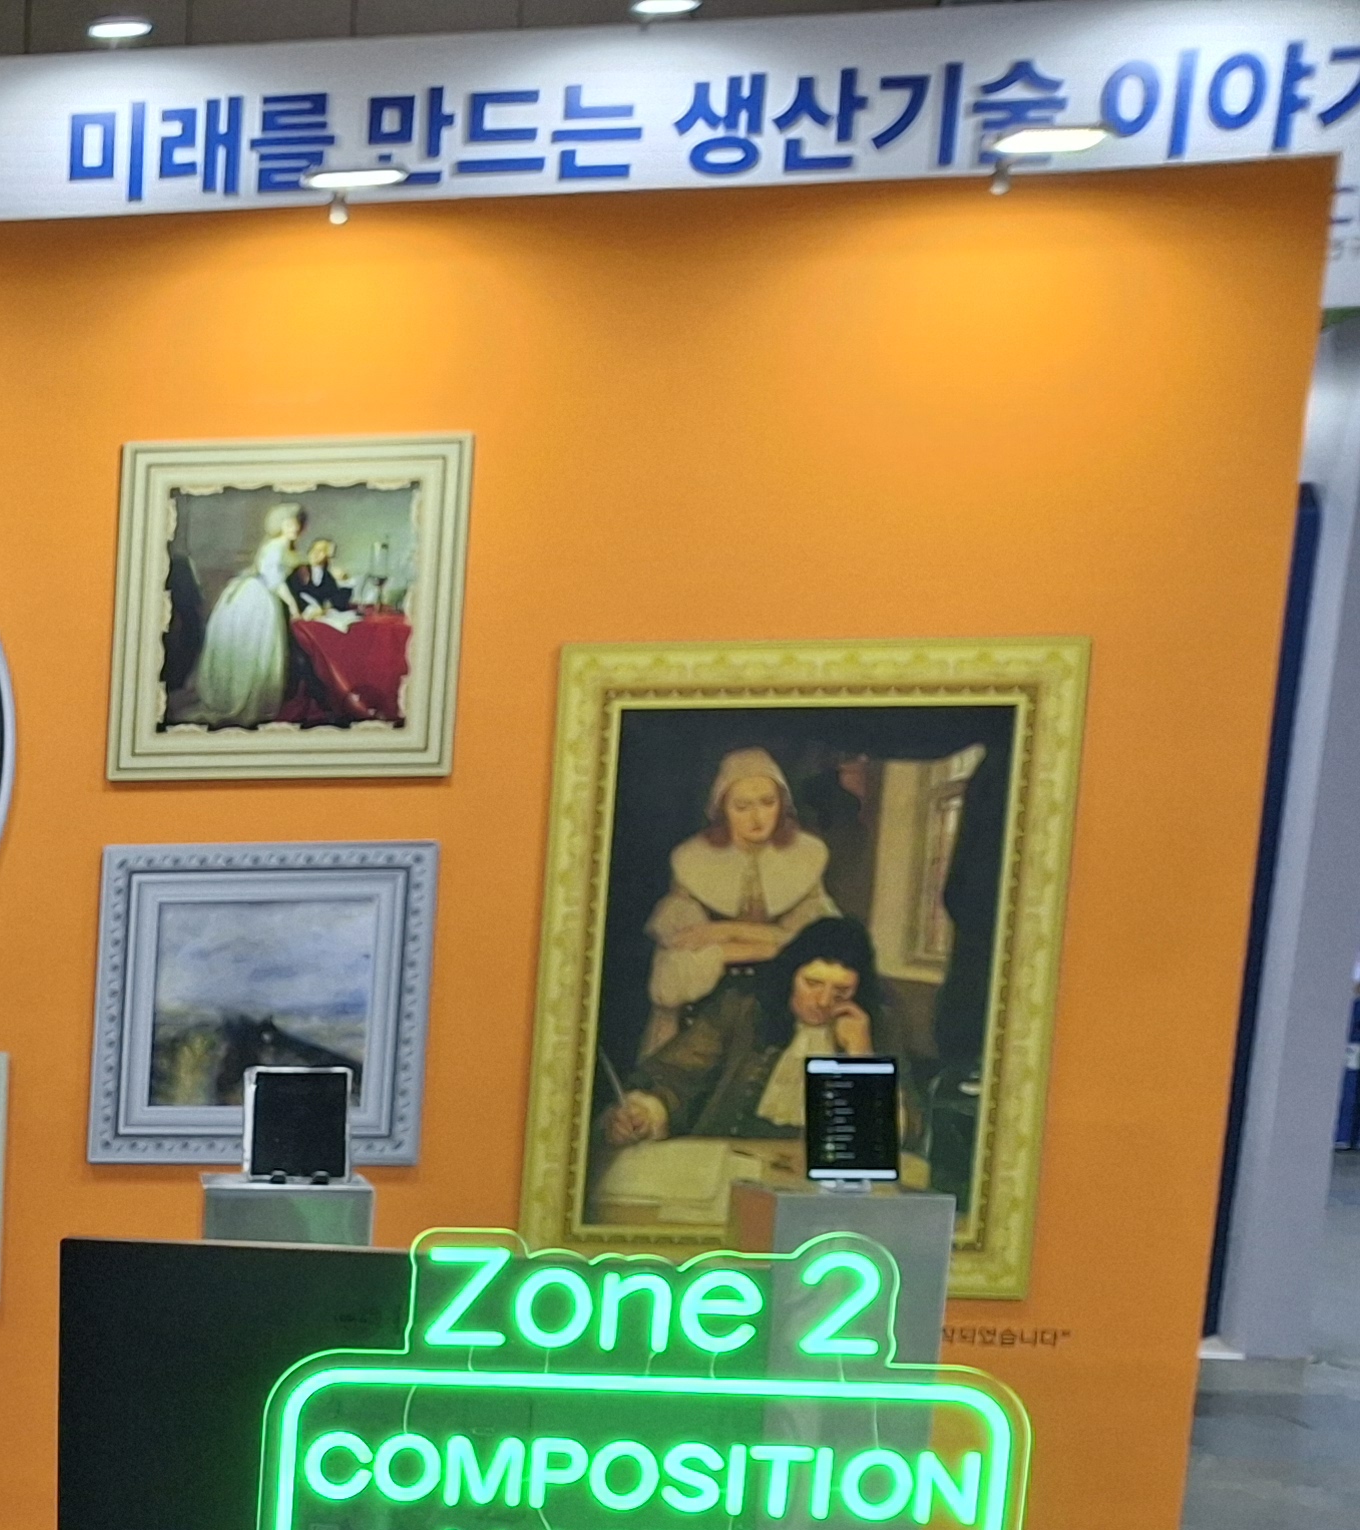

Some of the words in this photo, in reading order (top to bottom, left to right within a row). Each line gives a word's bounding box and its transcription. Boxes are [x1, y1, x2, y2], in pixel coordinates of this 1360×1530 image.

[67, 90, 337, 204] 미래를
[365, 82, 645, 190] 만드는
[670, 56, 1068, 180] 생산기술
[423, 1246, 766, 1354] Zone
[798, 1249, 882, 1357] 2
[304, 1429, 983, 1525] COMPOSITION
